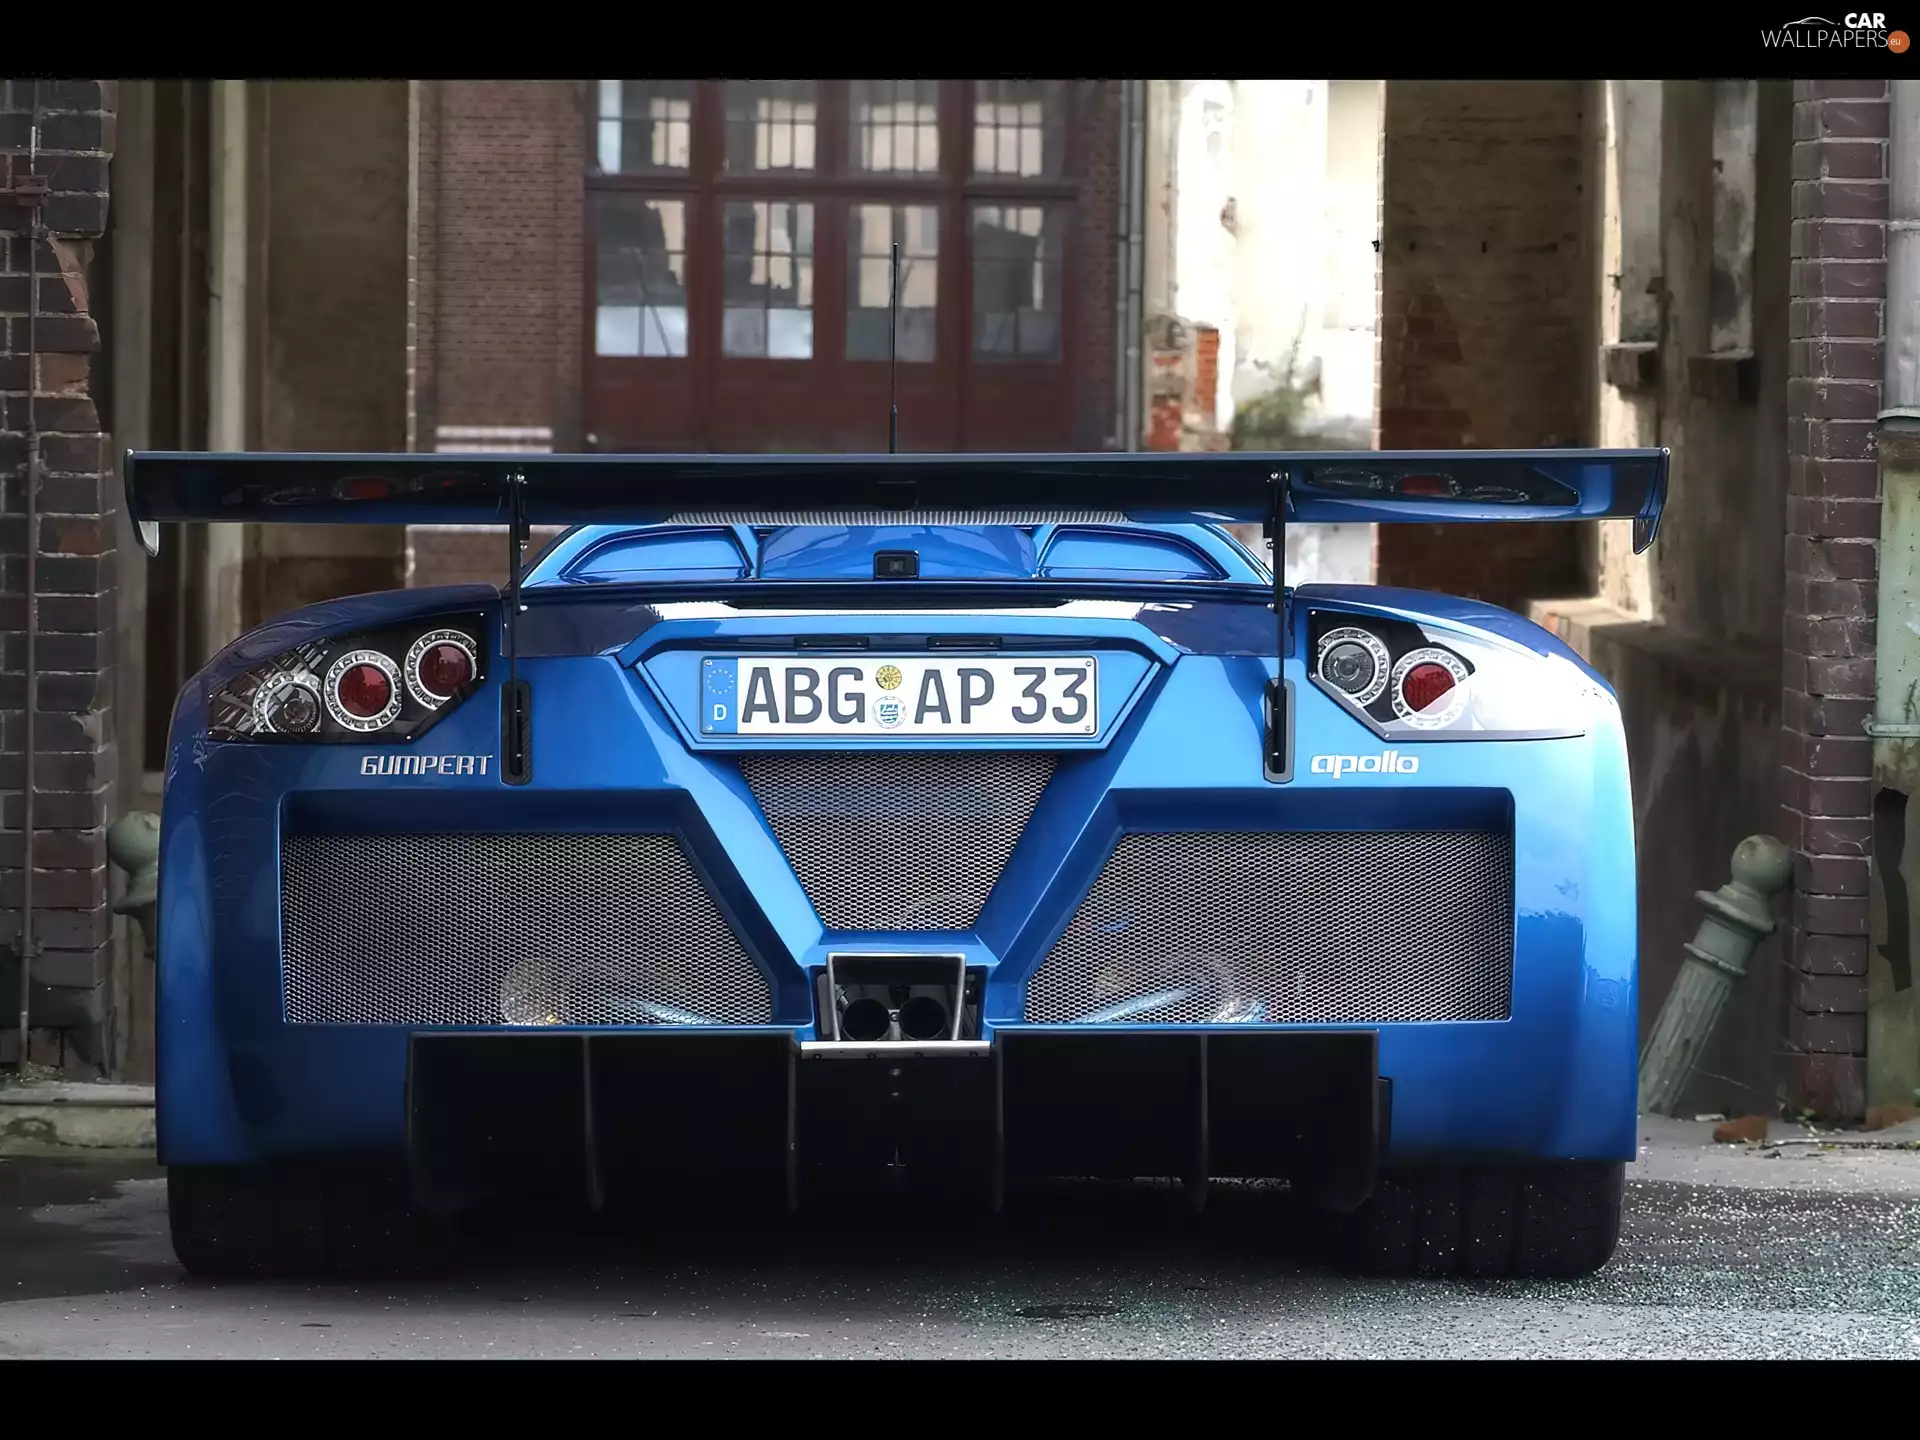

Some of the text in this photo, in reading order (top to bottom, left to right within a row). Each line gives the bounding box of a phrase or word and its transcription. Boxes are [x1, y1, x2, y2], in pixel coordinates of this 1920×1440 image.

[742, 667, 866, 724] ABG
[914, 669, 995, 724] AP
[1012, 667, 1088, 724] 33
[713, 704, 727, 721] D
[360, 755, 493, 775] GUMPERT
[1311, 750, 1419, 779] apollo
